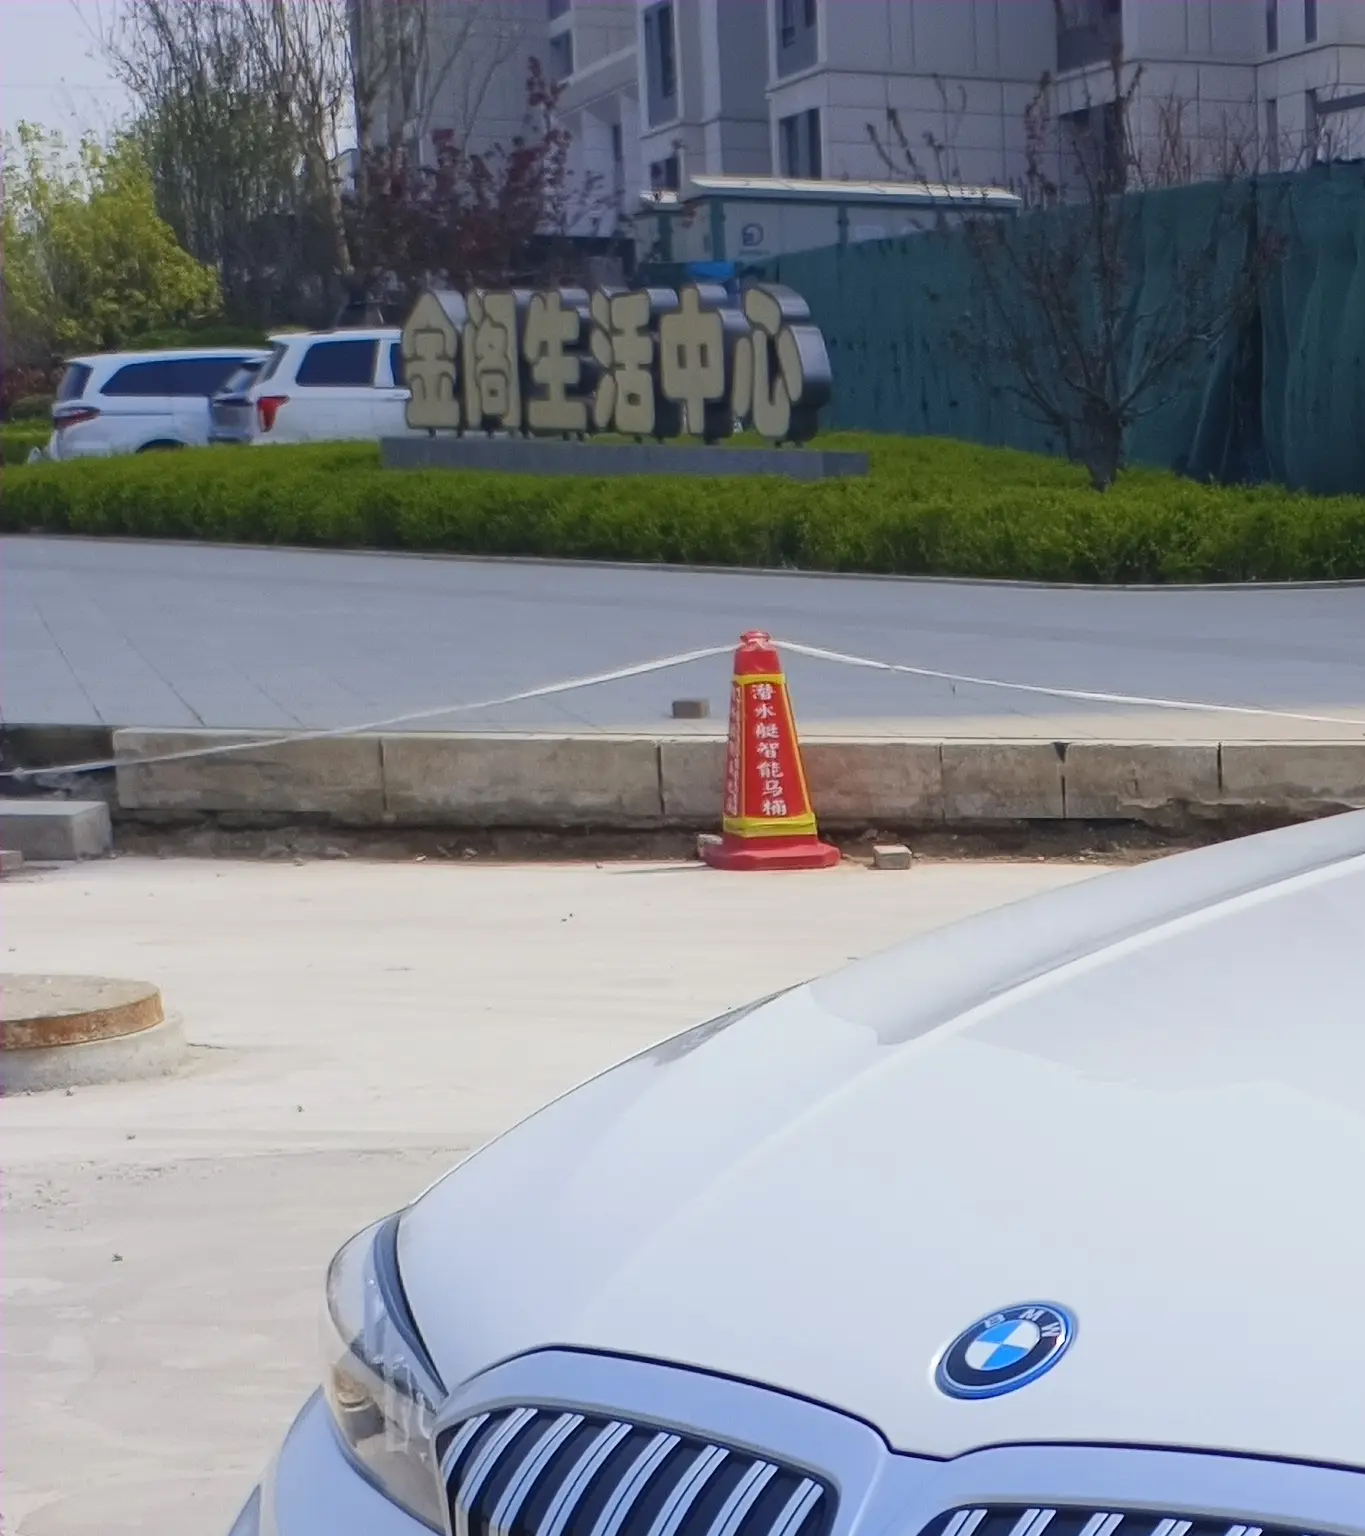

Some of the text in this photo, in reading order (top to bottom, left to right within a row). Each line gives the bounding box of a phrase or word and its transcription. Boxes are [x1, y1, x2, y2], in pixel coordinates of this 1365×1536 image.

[402, 286, 805, 439] 金阁生活中心
[750, 683, 788, 817] 潜水艇智能马桶
[983, 1308, 1061, 1338] BMW
